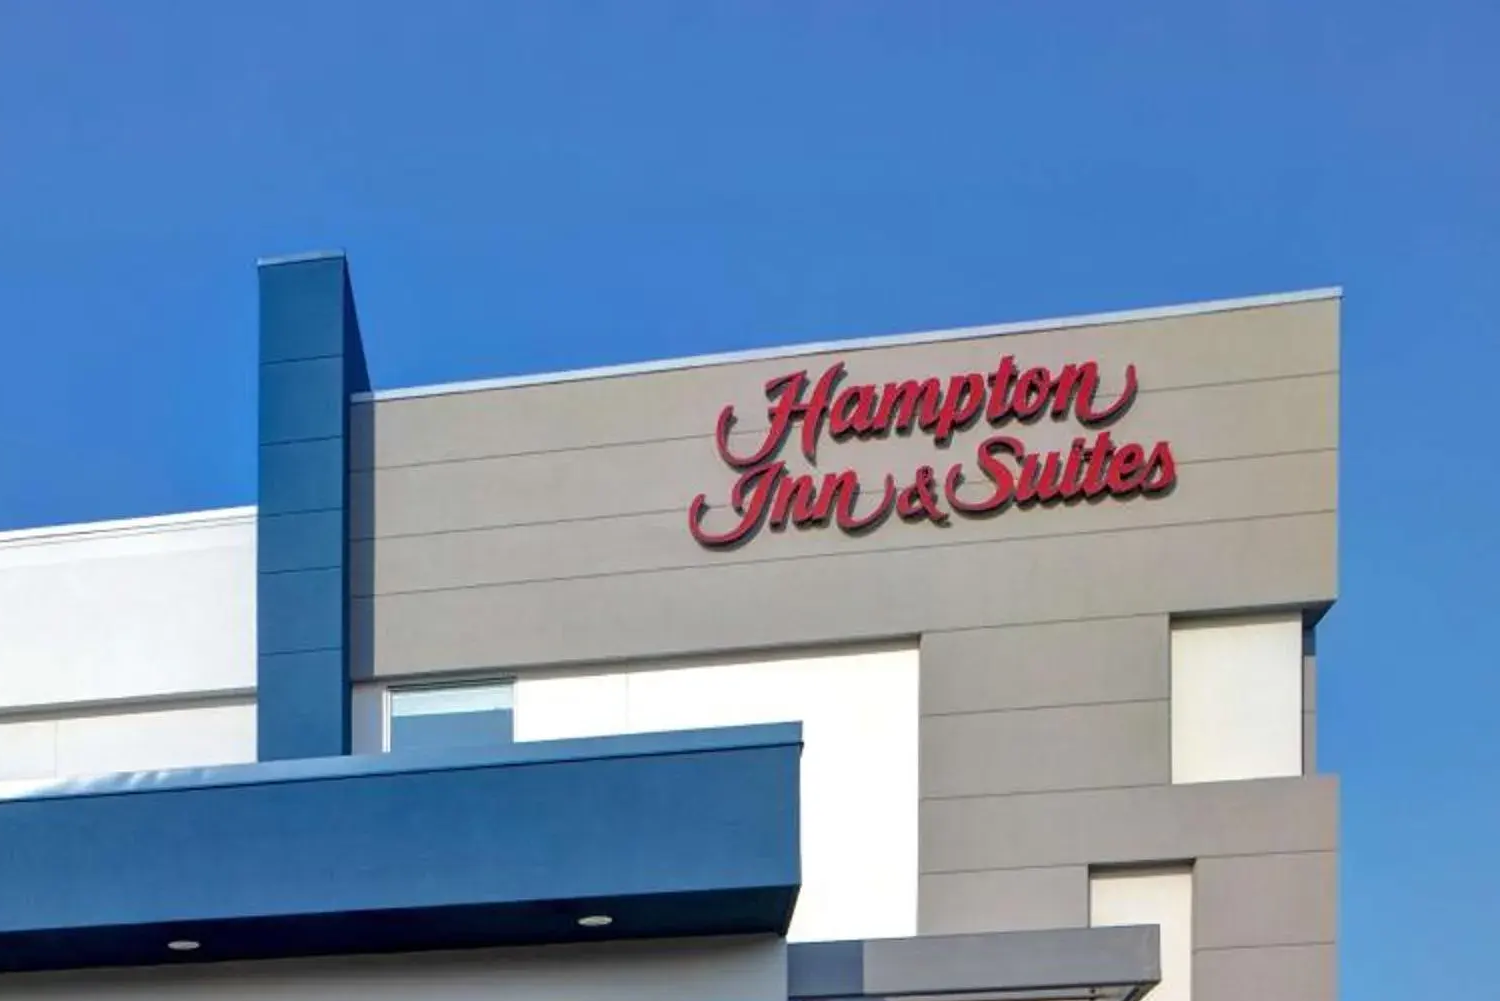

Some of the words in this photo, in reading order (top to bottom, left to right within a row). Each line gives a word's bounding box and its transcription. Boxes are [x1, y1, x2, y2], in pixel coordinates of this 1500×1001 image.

[716, 354, 1139, 467] Hampton
[688, 460, 894, 548] Inn
[896, 464, 950, 526] &
[944, 431, 1179, 513] Suites
